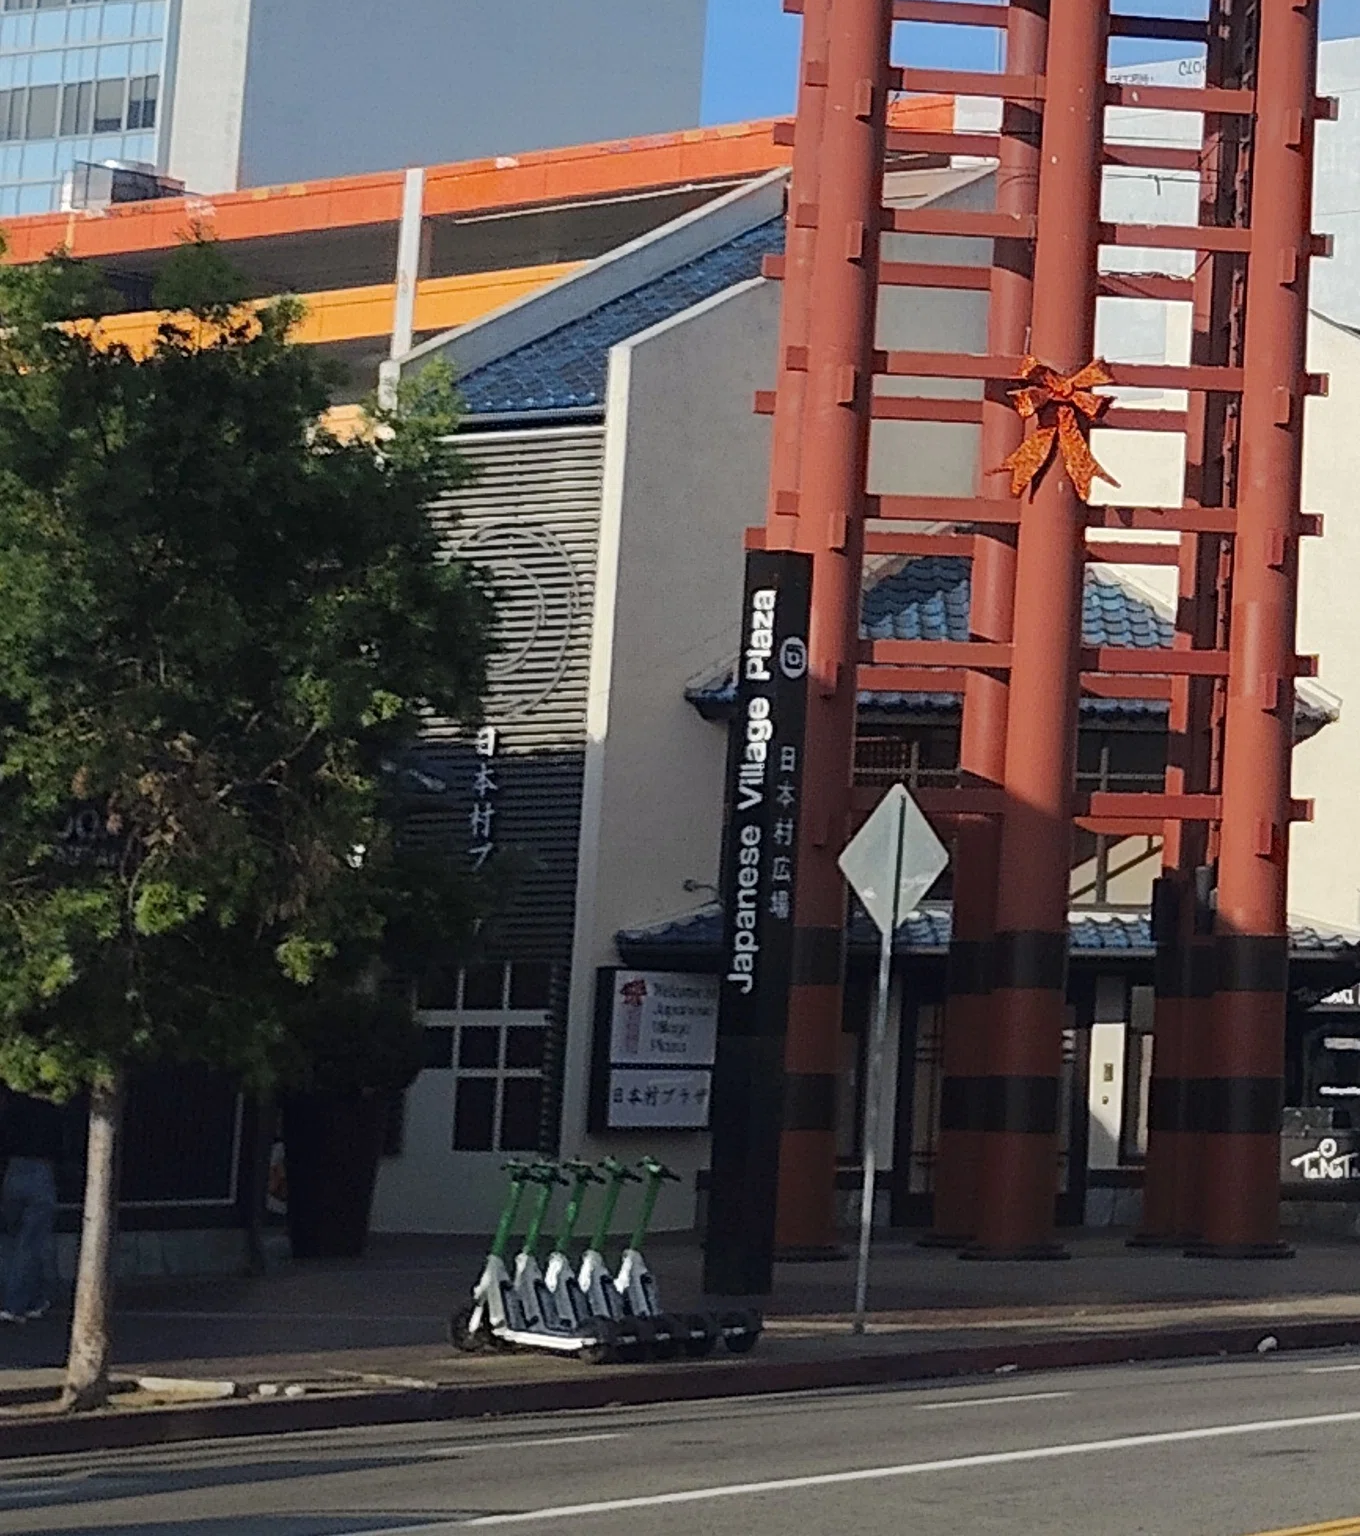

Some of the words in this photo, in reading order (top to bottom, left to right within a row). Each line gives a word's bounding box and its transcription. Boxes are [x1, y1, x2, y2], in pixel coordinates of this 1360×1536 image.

[745, 588, 778, 682] Plaza
[736, 695, 773, 812] Village
[726, 825, 762, 994] Japanese
